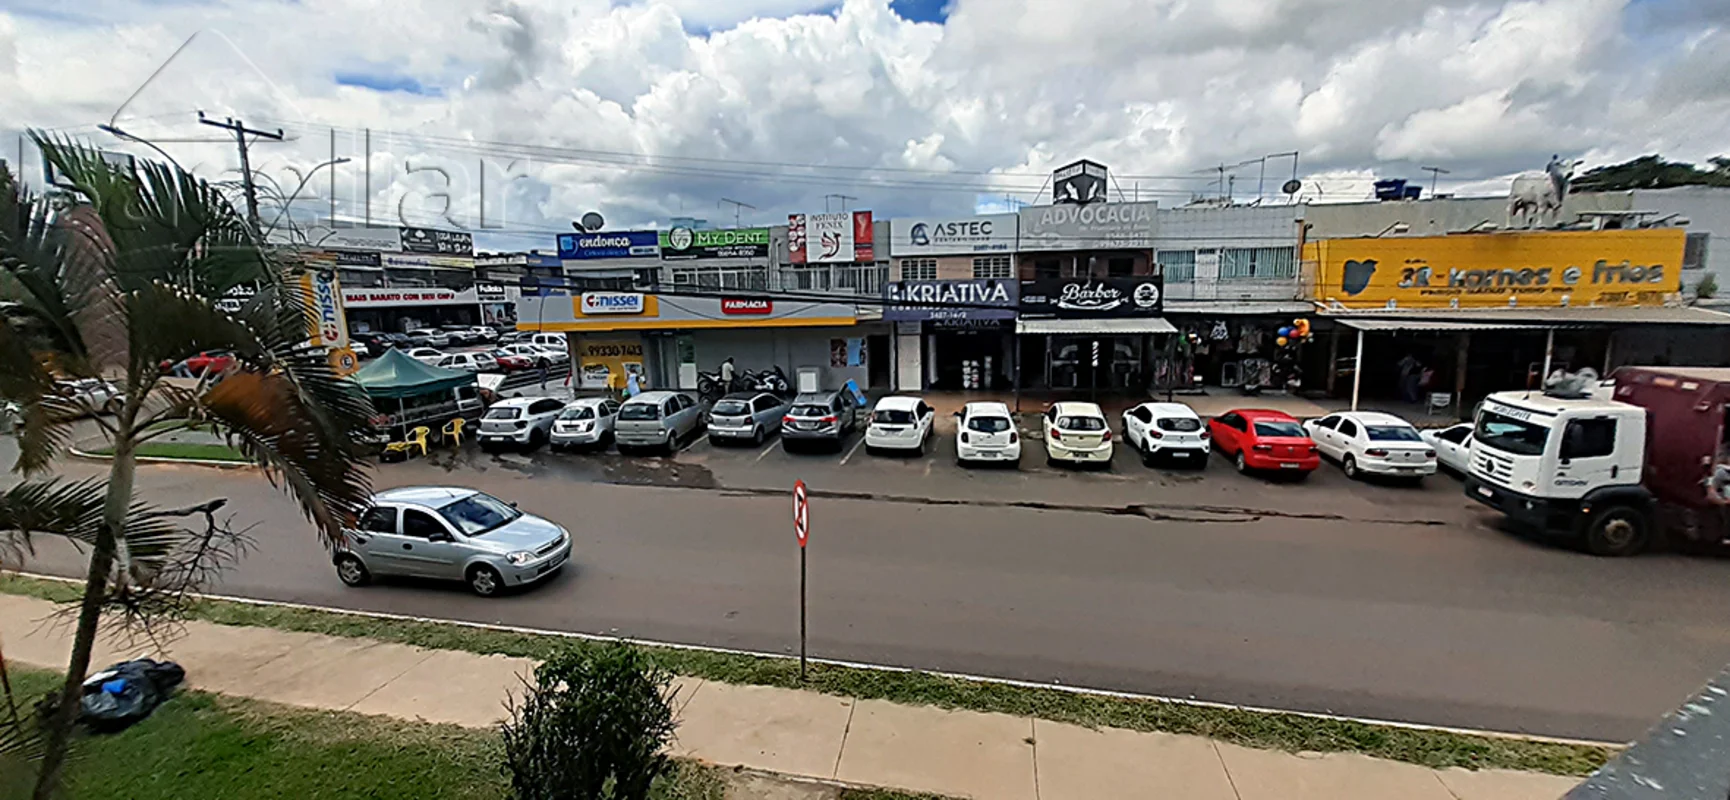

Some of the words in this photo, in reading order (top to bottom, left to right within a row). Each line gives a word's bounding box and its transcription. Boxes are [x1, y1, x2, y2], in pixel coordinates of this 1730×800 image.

[810, 213, 849, 222] INSTITUTO
[1040, 204, 1151, 225] ADVOCACIA
[933, 221, 993, 236] ASTEC
[346, 294, 367, 302] MAIS
[370, 293, 401, 301] BARATO
[906, 283, 1009, 303] KRIATIVA
[599, 294, 639, 306] nissei
